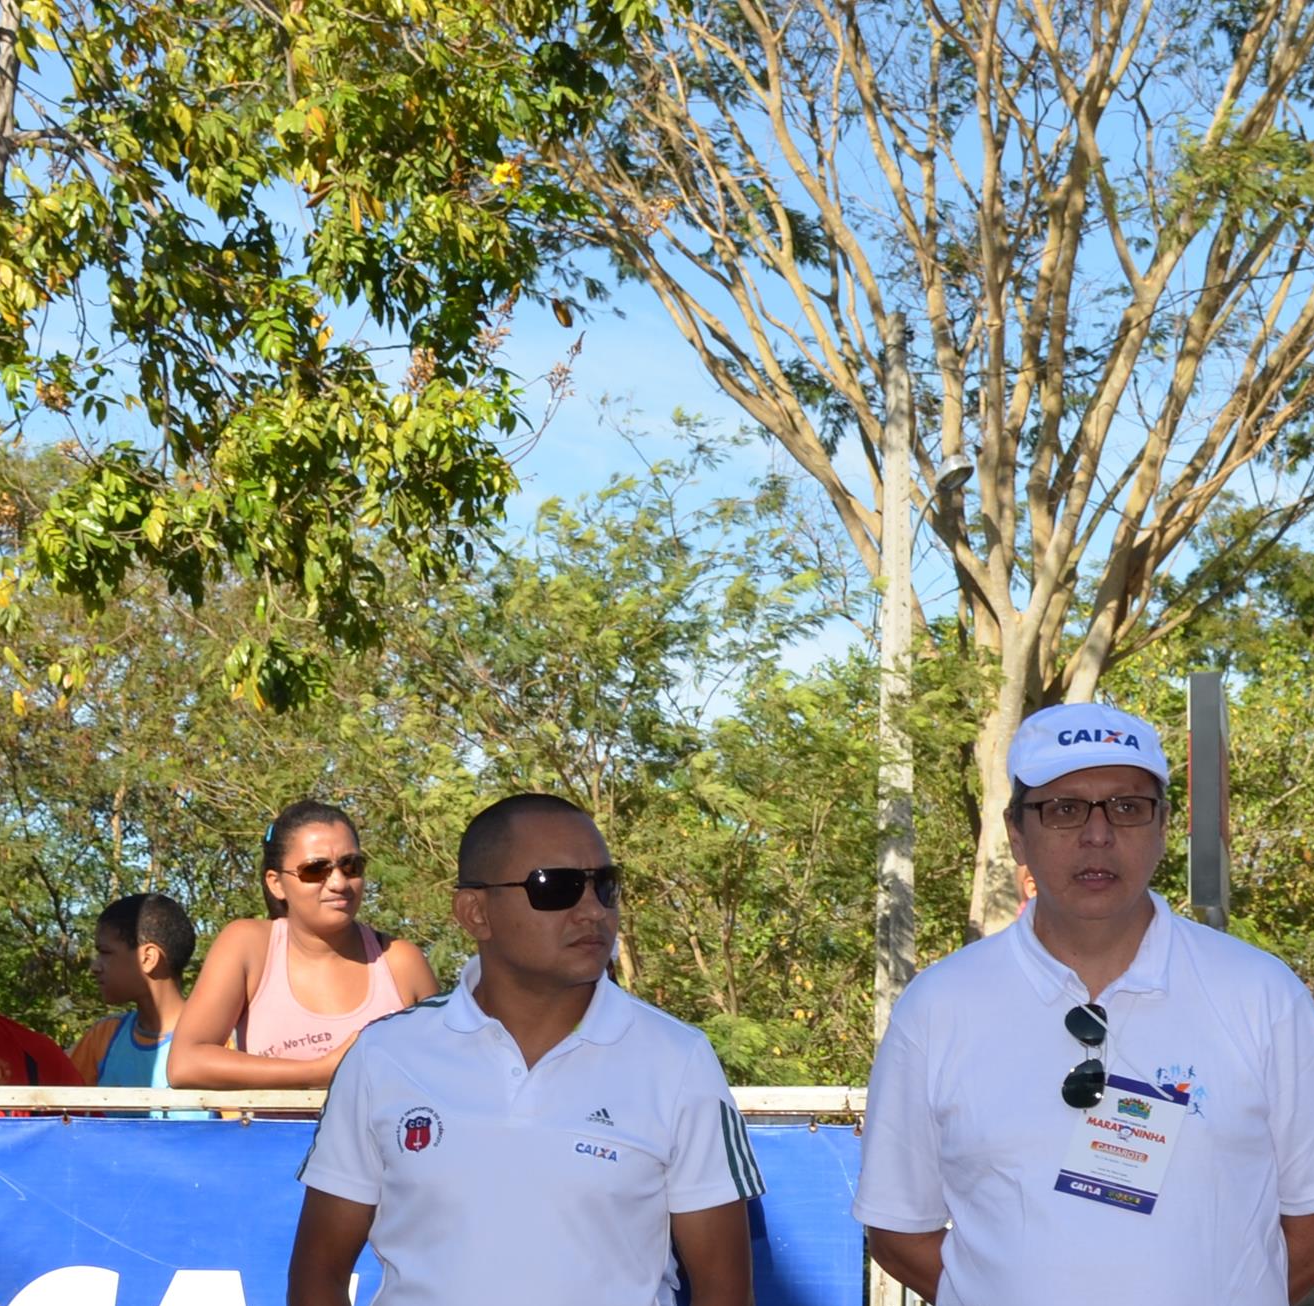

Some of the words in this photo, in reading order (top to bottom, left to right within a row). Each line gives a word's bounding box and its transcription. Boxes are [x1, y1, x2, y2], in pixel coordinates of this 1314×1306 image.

[1058, 729, 1140, 751] CAIXA
[283, 1032, 332, 1050] NOTICED
[575, 1142, 618, 1162] CAIXA
[1097, 1143, 1146, 1162] CAMAROTE
[1070, 1181, 1102, 1196] CAIXA
